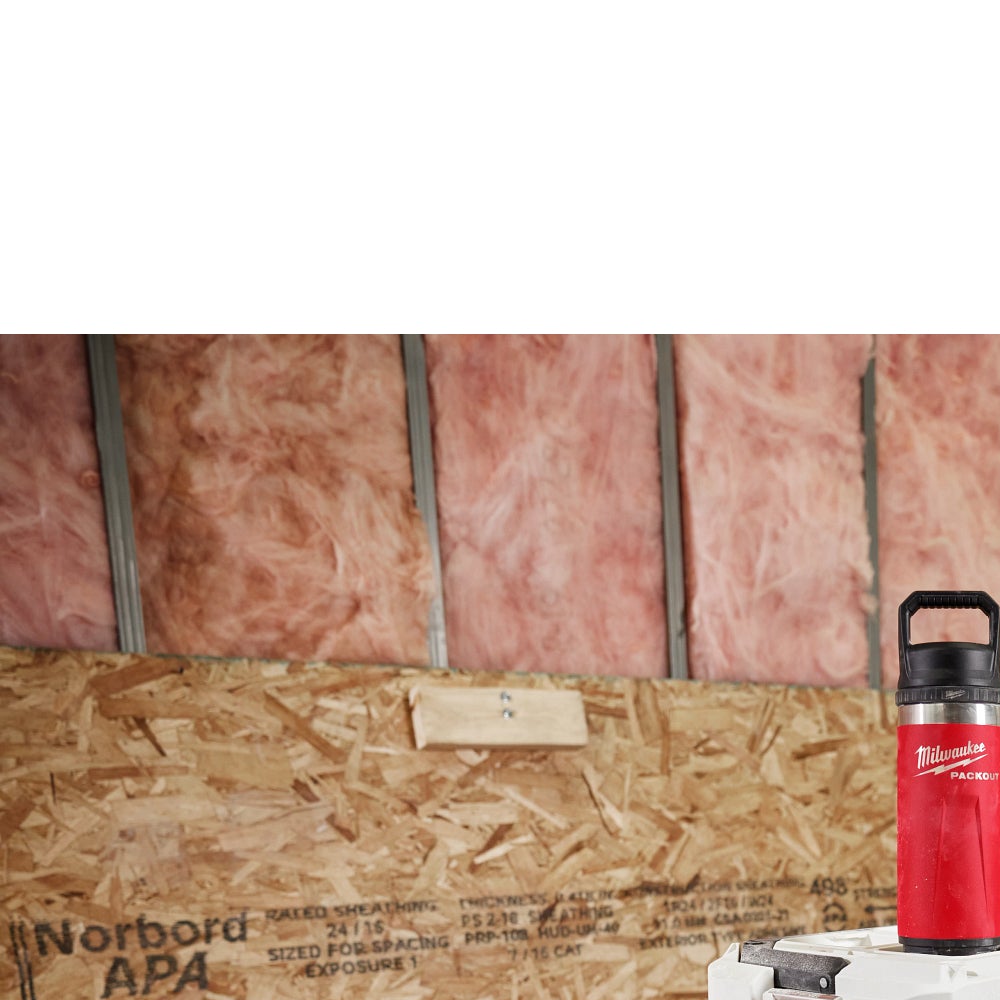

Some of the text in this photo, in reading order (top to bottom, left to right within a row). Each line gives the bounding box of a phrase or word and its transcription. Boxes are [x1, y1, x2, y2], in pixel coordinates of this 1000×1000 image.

[914, 740, 986, 770] Milwaukee
[950, 771, 999, 781] PACKOUT
[265, 906, 327, 921] RATED
[34, 911, 249, 956] Norbord
[267, 935, 450, 962] SIZED FOR SPACING
[553, 943, 584, 957] CAT
[100, 951, 209, 999] APA
[305, 956, 404, 979] EXPOSURE
